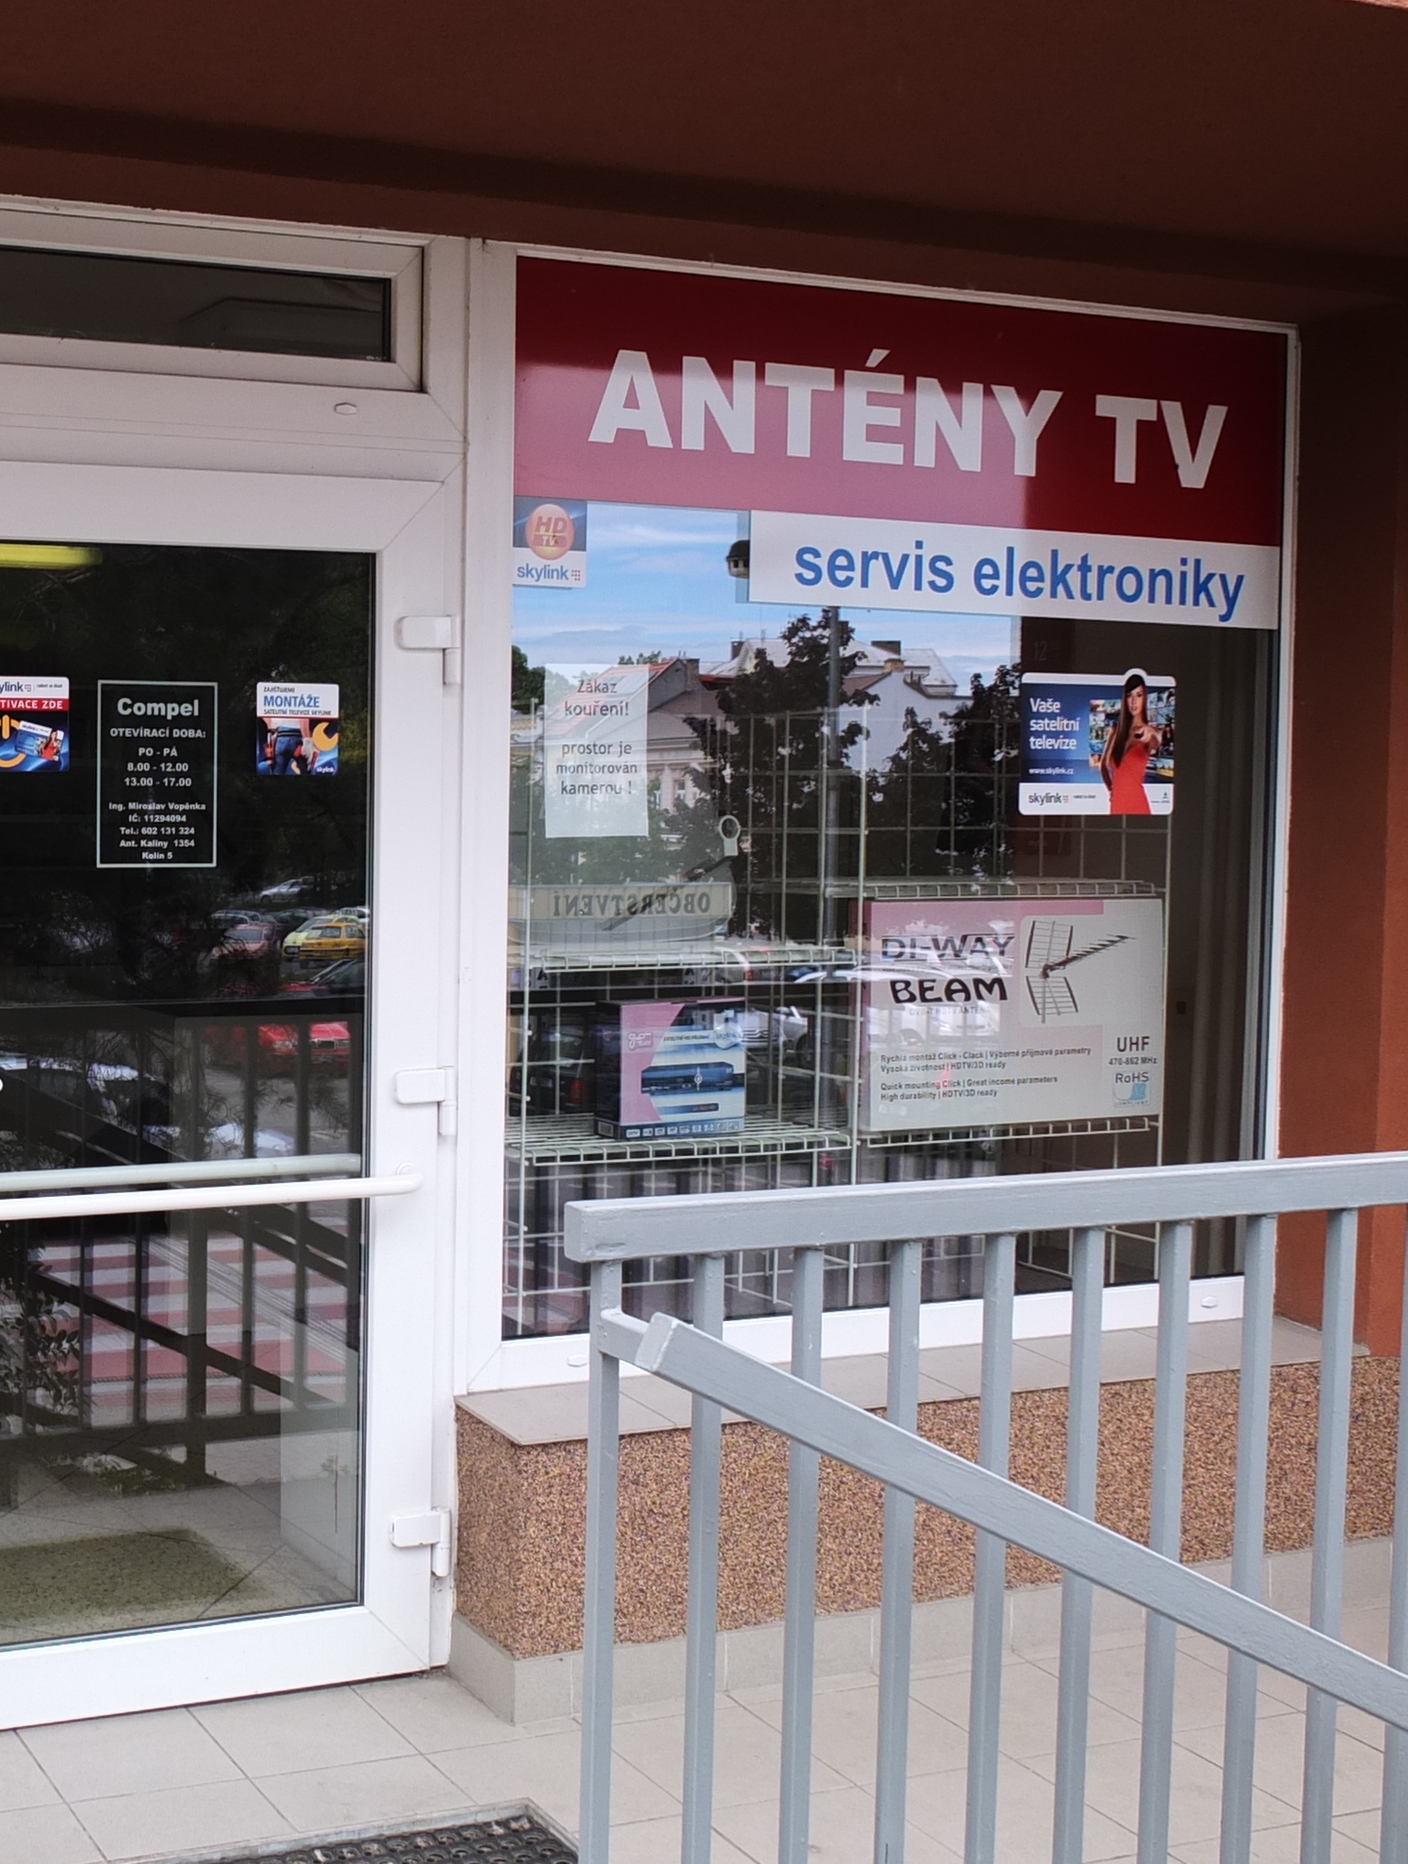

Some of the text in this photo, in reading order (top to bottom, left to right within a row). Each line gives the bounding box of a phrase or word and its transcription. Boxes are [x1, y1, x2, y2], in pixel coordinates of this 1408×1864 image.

[587, 348, 1228, 489] ANTÉNY TV
[535, 516, 568, 533] HD
[542, 535, 557, 546] TV
[517, 563, 569, 582] skylink
[794, 540, 1245, 623] servis elektroniky
[577, 679, 618, 693] Zákaz
[42, 700, 63, 709] ZDE
[263, 694, 320, 708] MONTÁŽE
[565, 700, 629, 716] kouření!
[1030, 697, 1061, 713] Vaše
[117, 697, 199, 720] Compel
[1030, 716, 1080, 731] satelitní
[110, 726, 206, 738] OTEVÍRACÍ DOBA:
[1029, 735, 1077, 749] televize
[138, 747, 154, 757] PO
[163, 746, 178, 757] PÁ
[562, 741, 632, 758] prostor je
[127, 763, 150, 772] 8.00
[159, 763, 188, 772] 12.00
[556, 761, 638, 775] monitorován
[124, 777, 154, 787] 13.00
[163, 777, 192, 787] 17.00
[561, 781, 622, 795] kamerou
[1028, 792, 1062, 806] skylink
[109, 802, 125, 811] Ing.
[128, 802, 166, 810] Miroslav
[144, 814, 187, 822] 11294094
[119, 839, 195, 848] Ant. Kaliny 1354
[890, 977, 1008, 1004] BEAM
[1117, 1036, 1150, 1052] UHF
[938, 1052, 957, 1060] Click
[1054, 1047, 1091, 1057] parametry
[1140, 1056, 1158, 1064] MHz
[985, 1061, 1006, 1069] ready
[880, 1076, 1058, 1091] Quick mounting Click Great income parameters
[1115, 1071, 1149, 1083] RoHS
[880, 1093, 898, 1102] High
[900, 1091, 937, 1100] durability
[977, 1088, 997, 1097] ready
